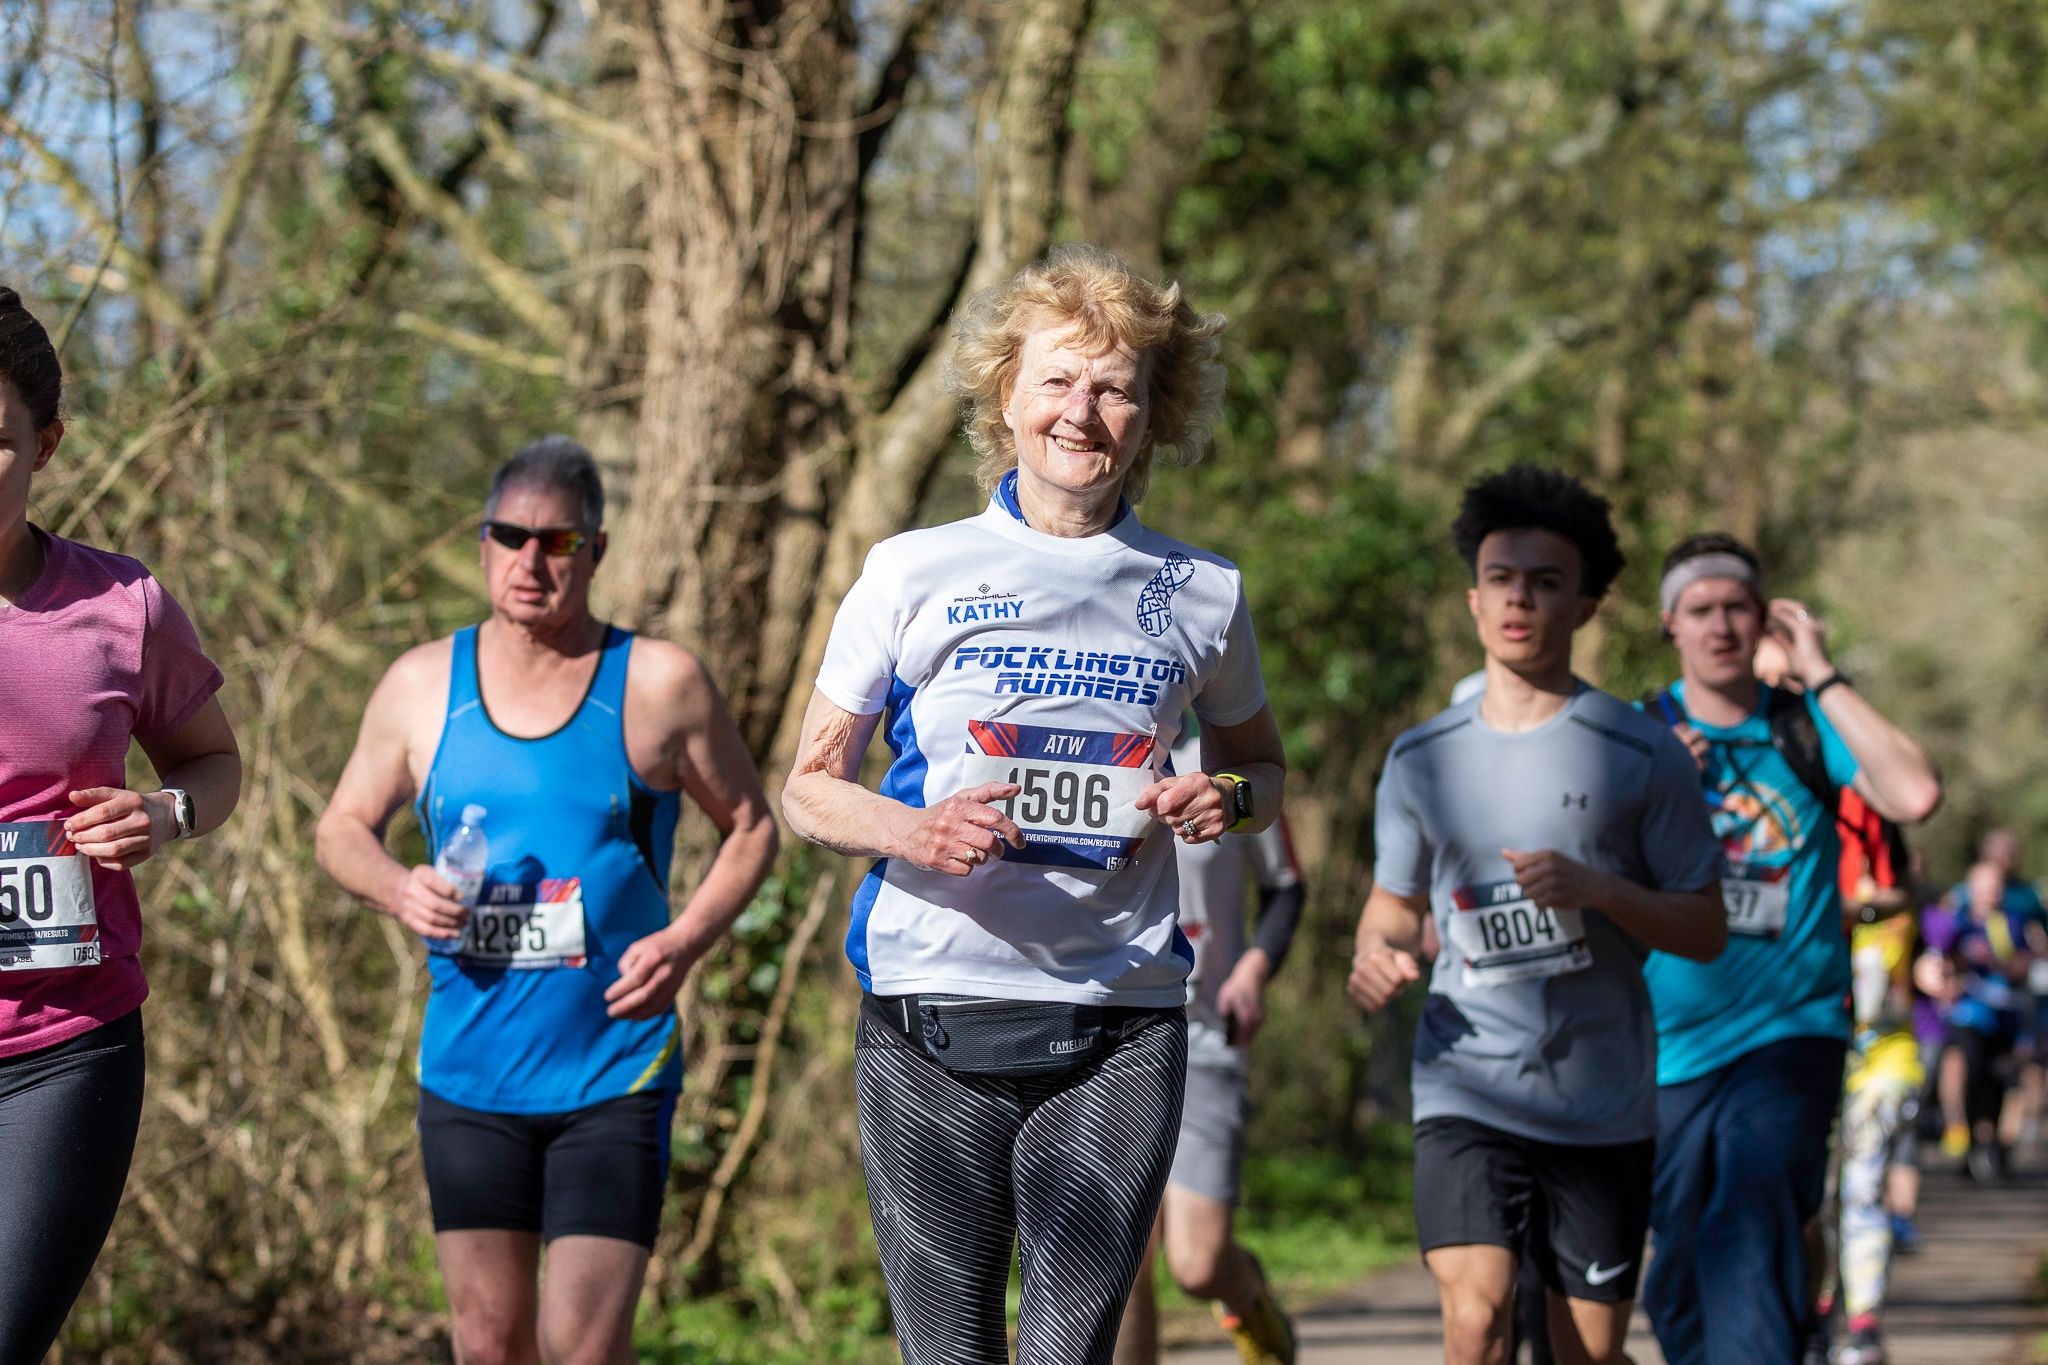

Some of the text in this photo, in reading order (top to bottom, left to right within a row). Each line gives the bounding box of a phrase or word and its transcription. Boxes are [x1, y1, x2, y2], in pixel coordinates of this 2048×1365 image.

[954, 592, 1017, 602] RONHILL
[947, 600, 1025, 625] KATHY
[954, 645, 1187, 685] POCKLINGTON
[994, 671, 1160, 707] RUNNERS
[1043, 734, 1086, 756] ATW
[1006, 767, 1109, 829] 1596
[0, 831, 19, 852] W
[1026, 833, 1120, 846] EVENTCHIPTIMING.COM/RESULTS
[489, 885, 523, 903] ATW
[1491, 882, 1523, 903] ATW
[472, 912, 546, 952] 1295
[1479, 907, 1555, 952] 1804
[73, 946, 95, 962] 1750
[1049, 1035, 1094, 1055] CAMELBAK
